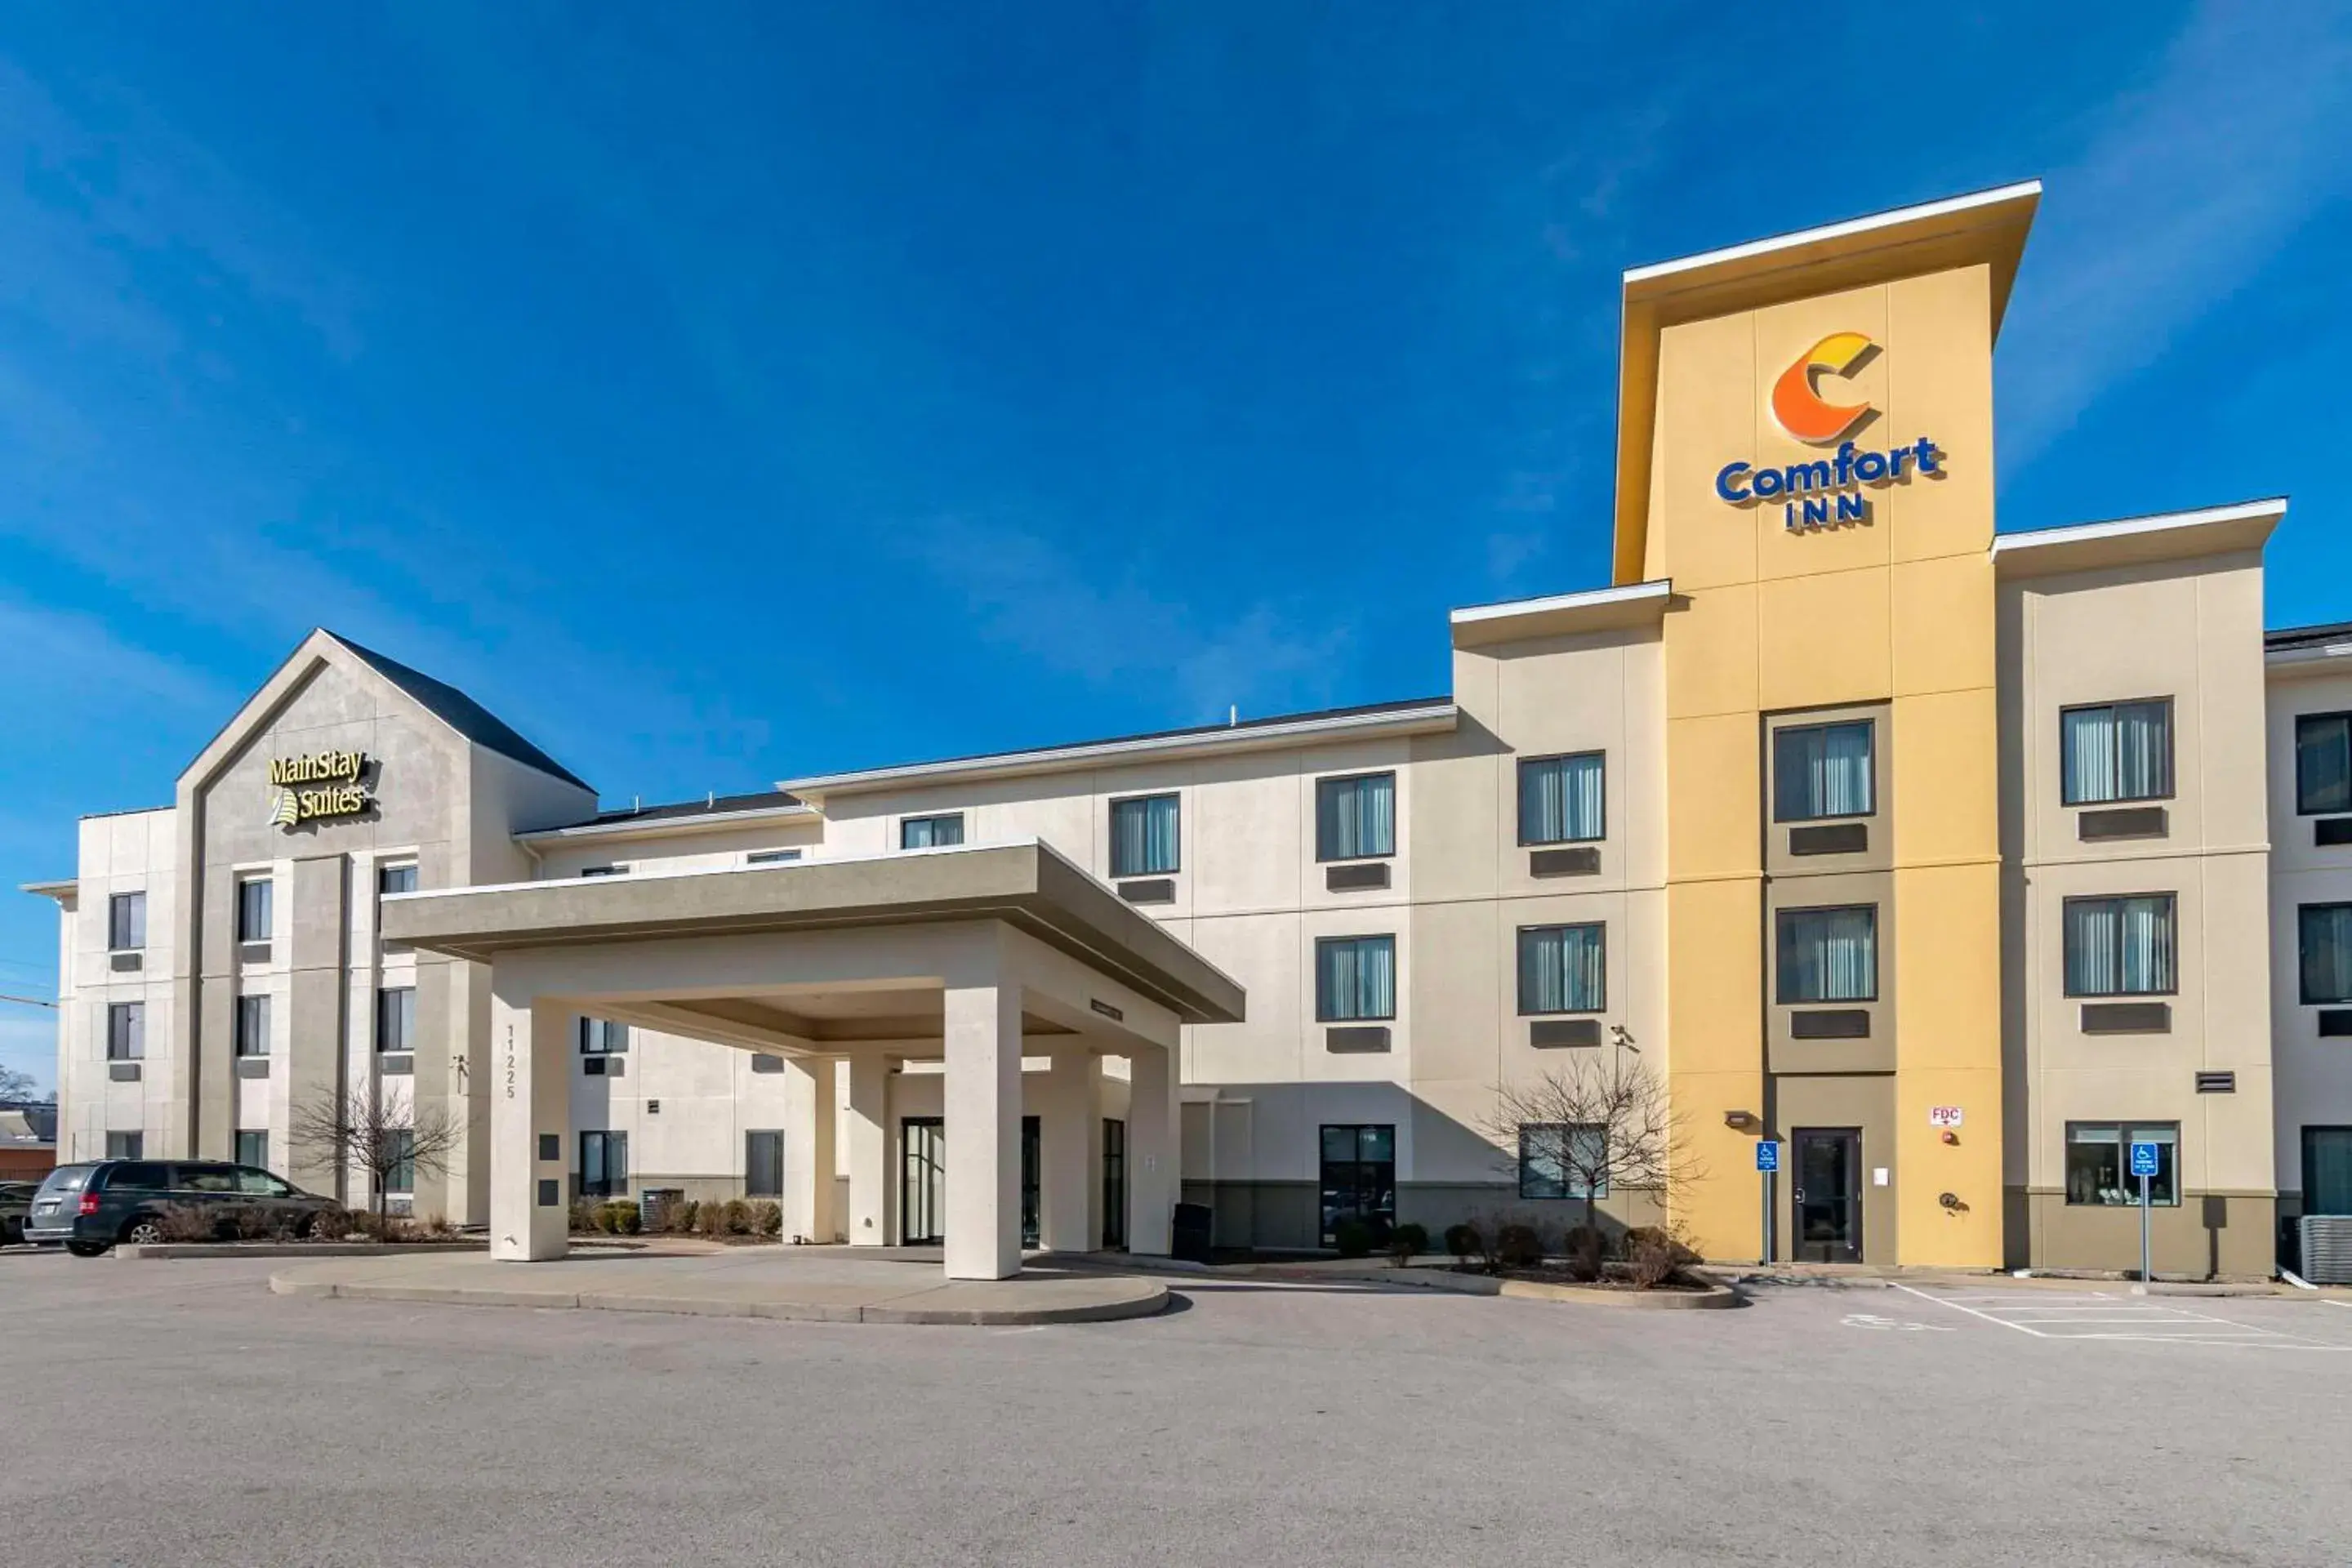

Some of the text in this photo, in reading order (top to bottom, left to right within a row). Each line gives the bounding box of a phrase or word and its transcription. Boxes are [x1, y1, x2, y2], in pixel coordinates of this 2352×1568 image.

[1716, 436, 1939, 503] Comfort
[1785, 492, 1864, 530] INN
[270, 749, 363, 784] MainStay
[300, 786, 363, 818] Suites
[506, 1024, 515, 1099] 11225
[1932, 1107, 1959, 1120] FDC
